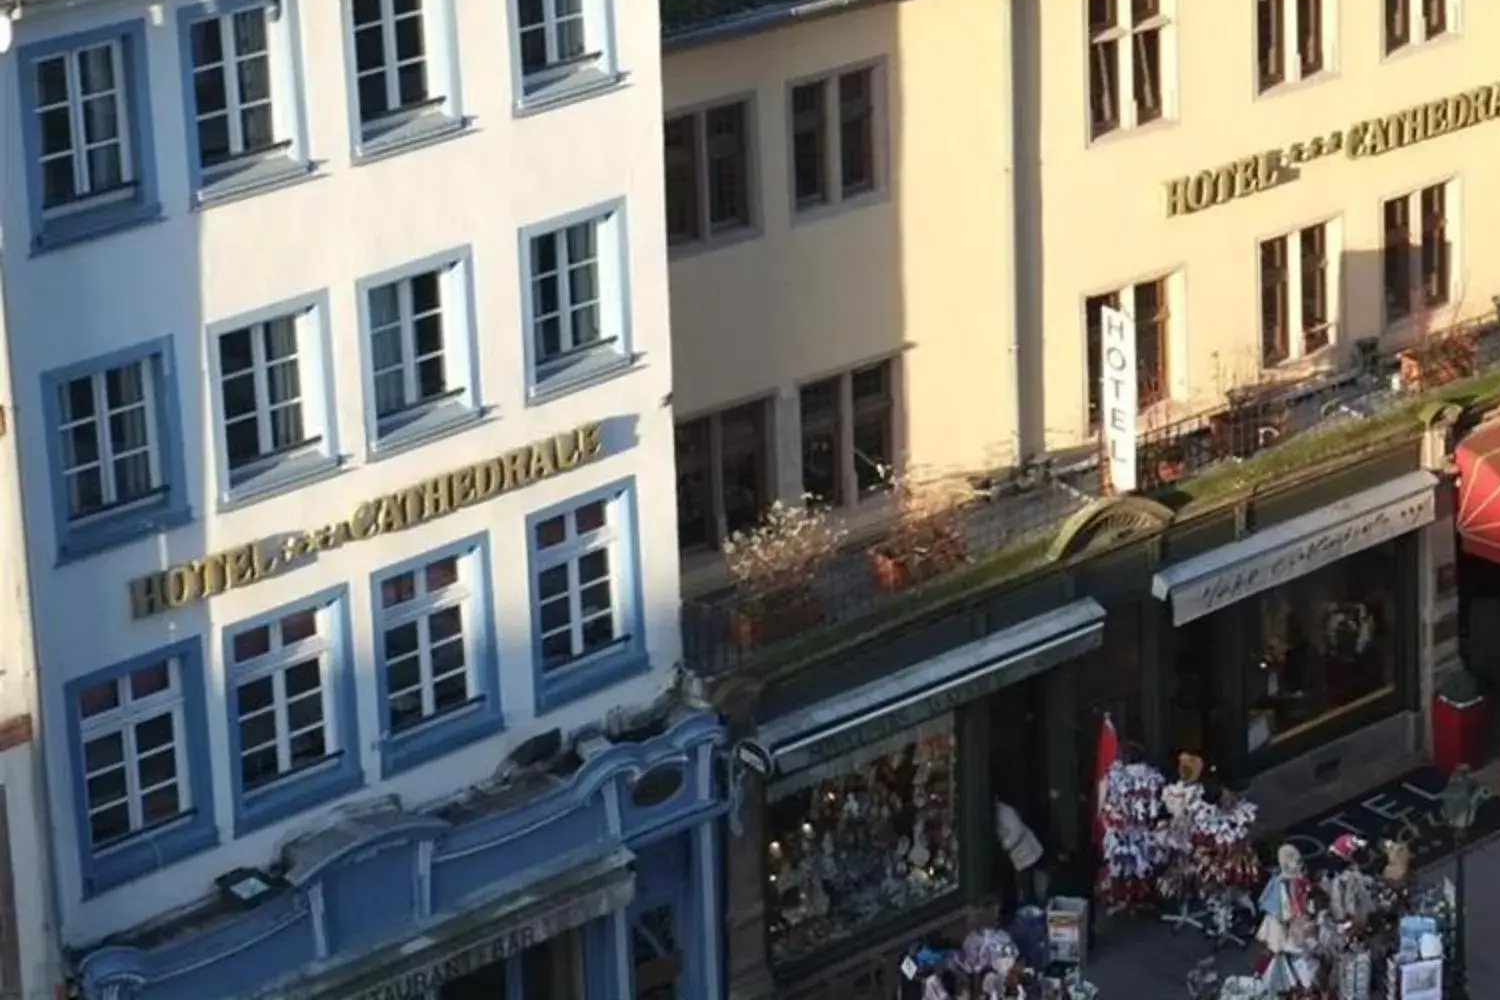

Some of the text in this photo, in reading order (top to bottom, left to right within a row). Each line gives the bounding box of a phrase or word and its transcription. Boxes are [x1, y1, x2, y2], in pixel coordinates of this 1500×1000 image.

[1164, 153, 1281, 216] HOTEL
[1105, 320, 1127, 463] HOTEL
[130, 424, 602, 619] HOTEL CATHEDRALE
